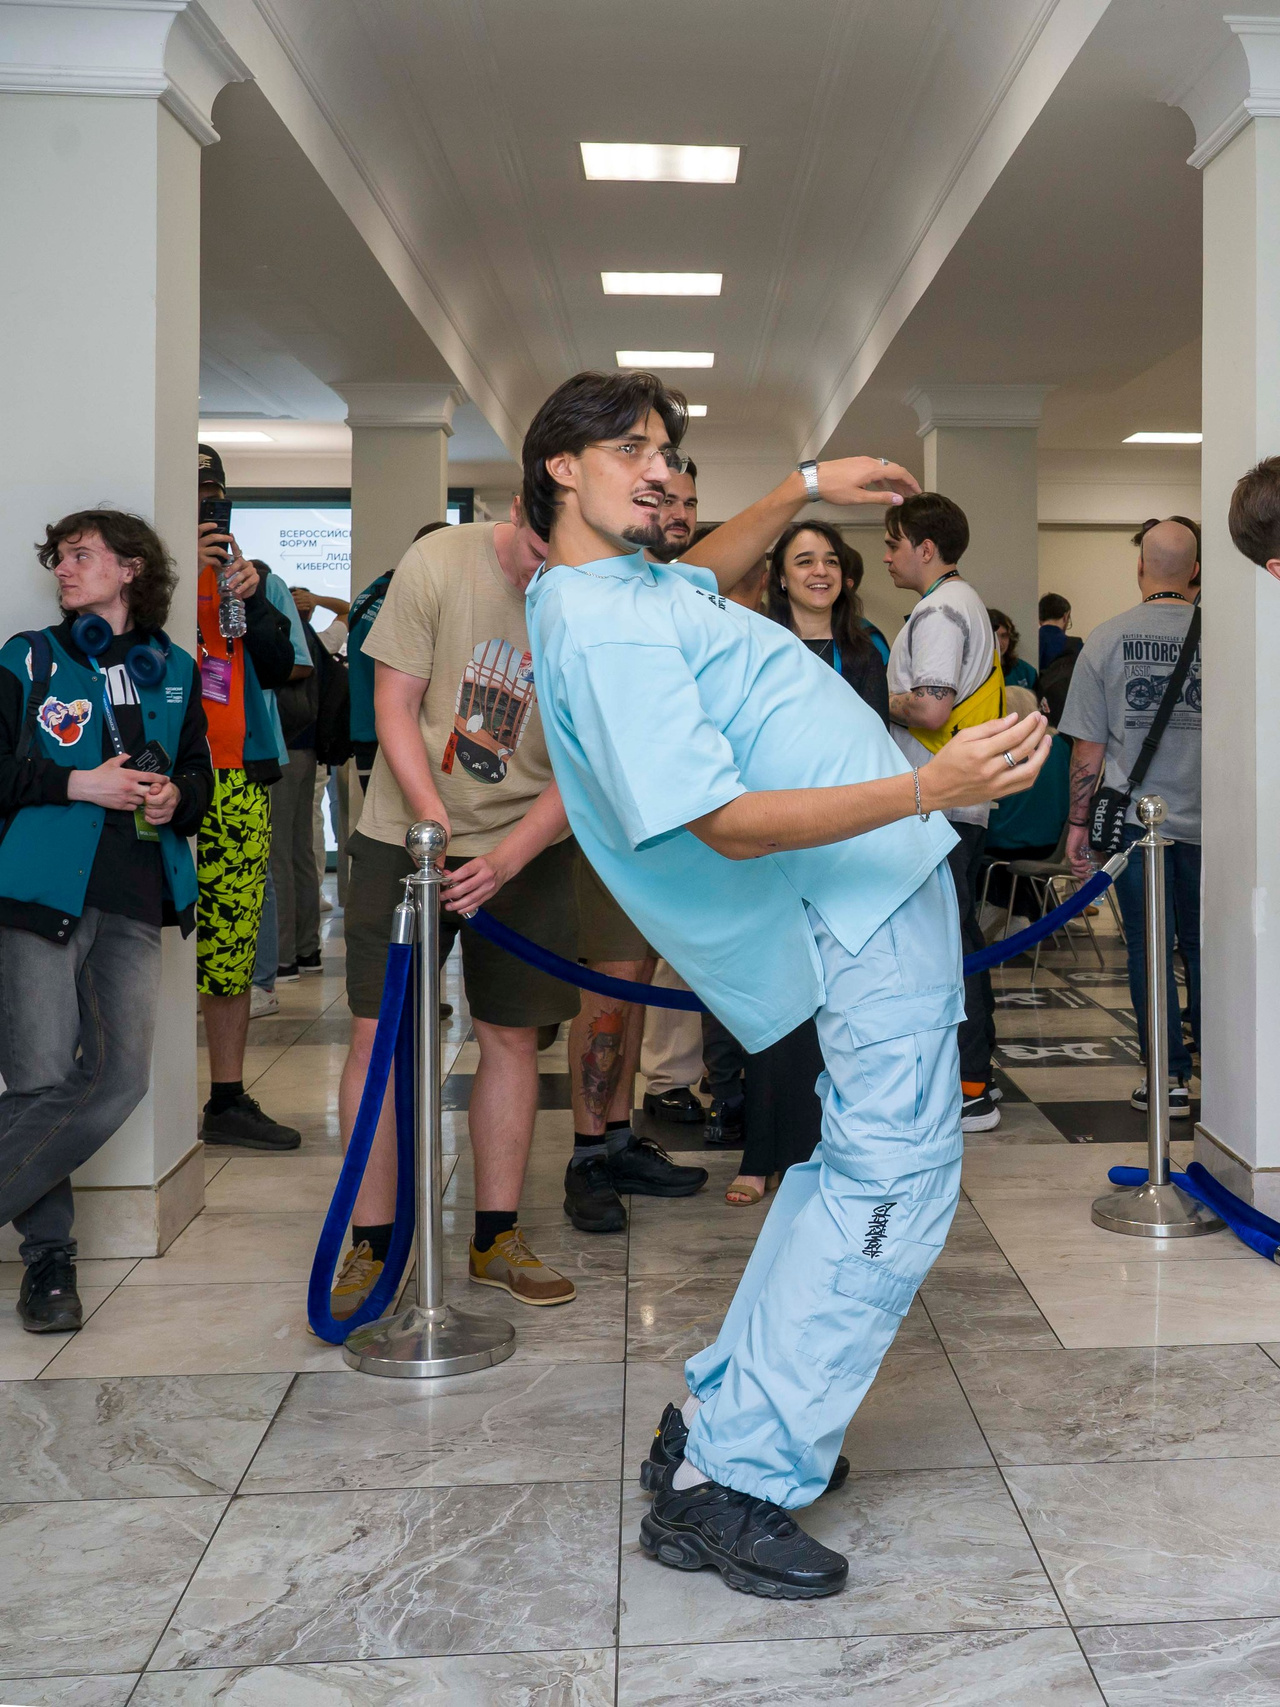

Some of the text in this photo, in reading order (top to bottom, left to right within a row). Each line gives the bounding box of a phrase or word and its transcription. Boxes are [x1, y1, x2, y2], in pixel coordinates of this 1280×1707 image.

[279, 528, 352, 538] ВСЕРОССИЙС
[279, 539, 317, 548] ФОРУМ
[296, 562, 351, 571] КИБЕРСПО
[1091, 798, 1110, 842] Kappa
